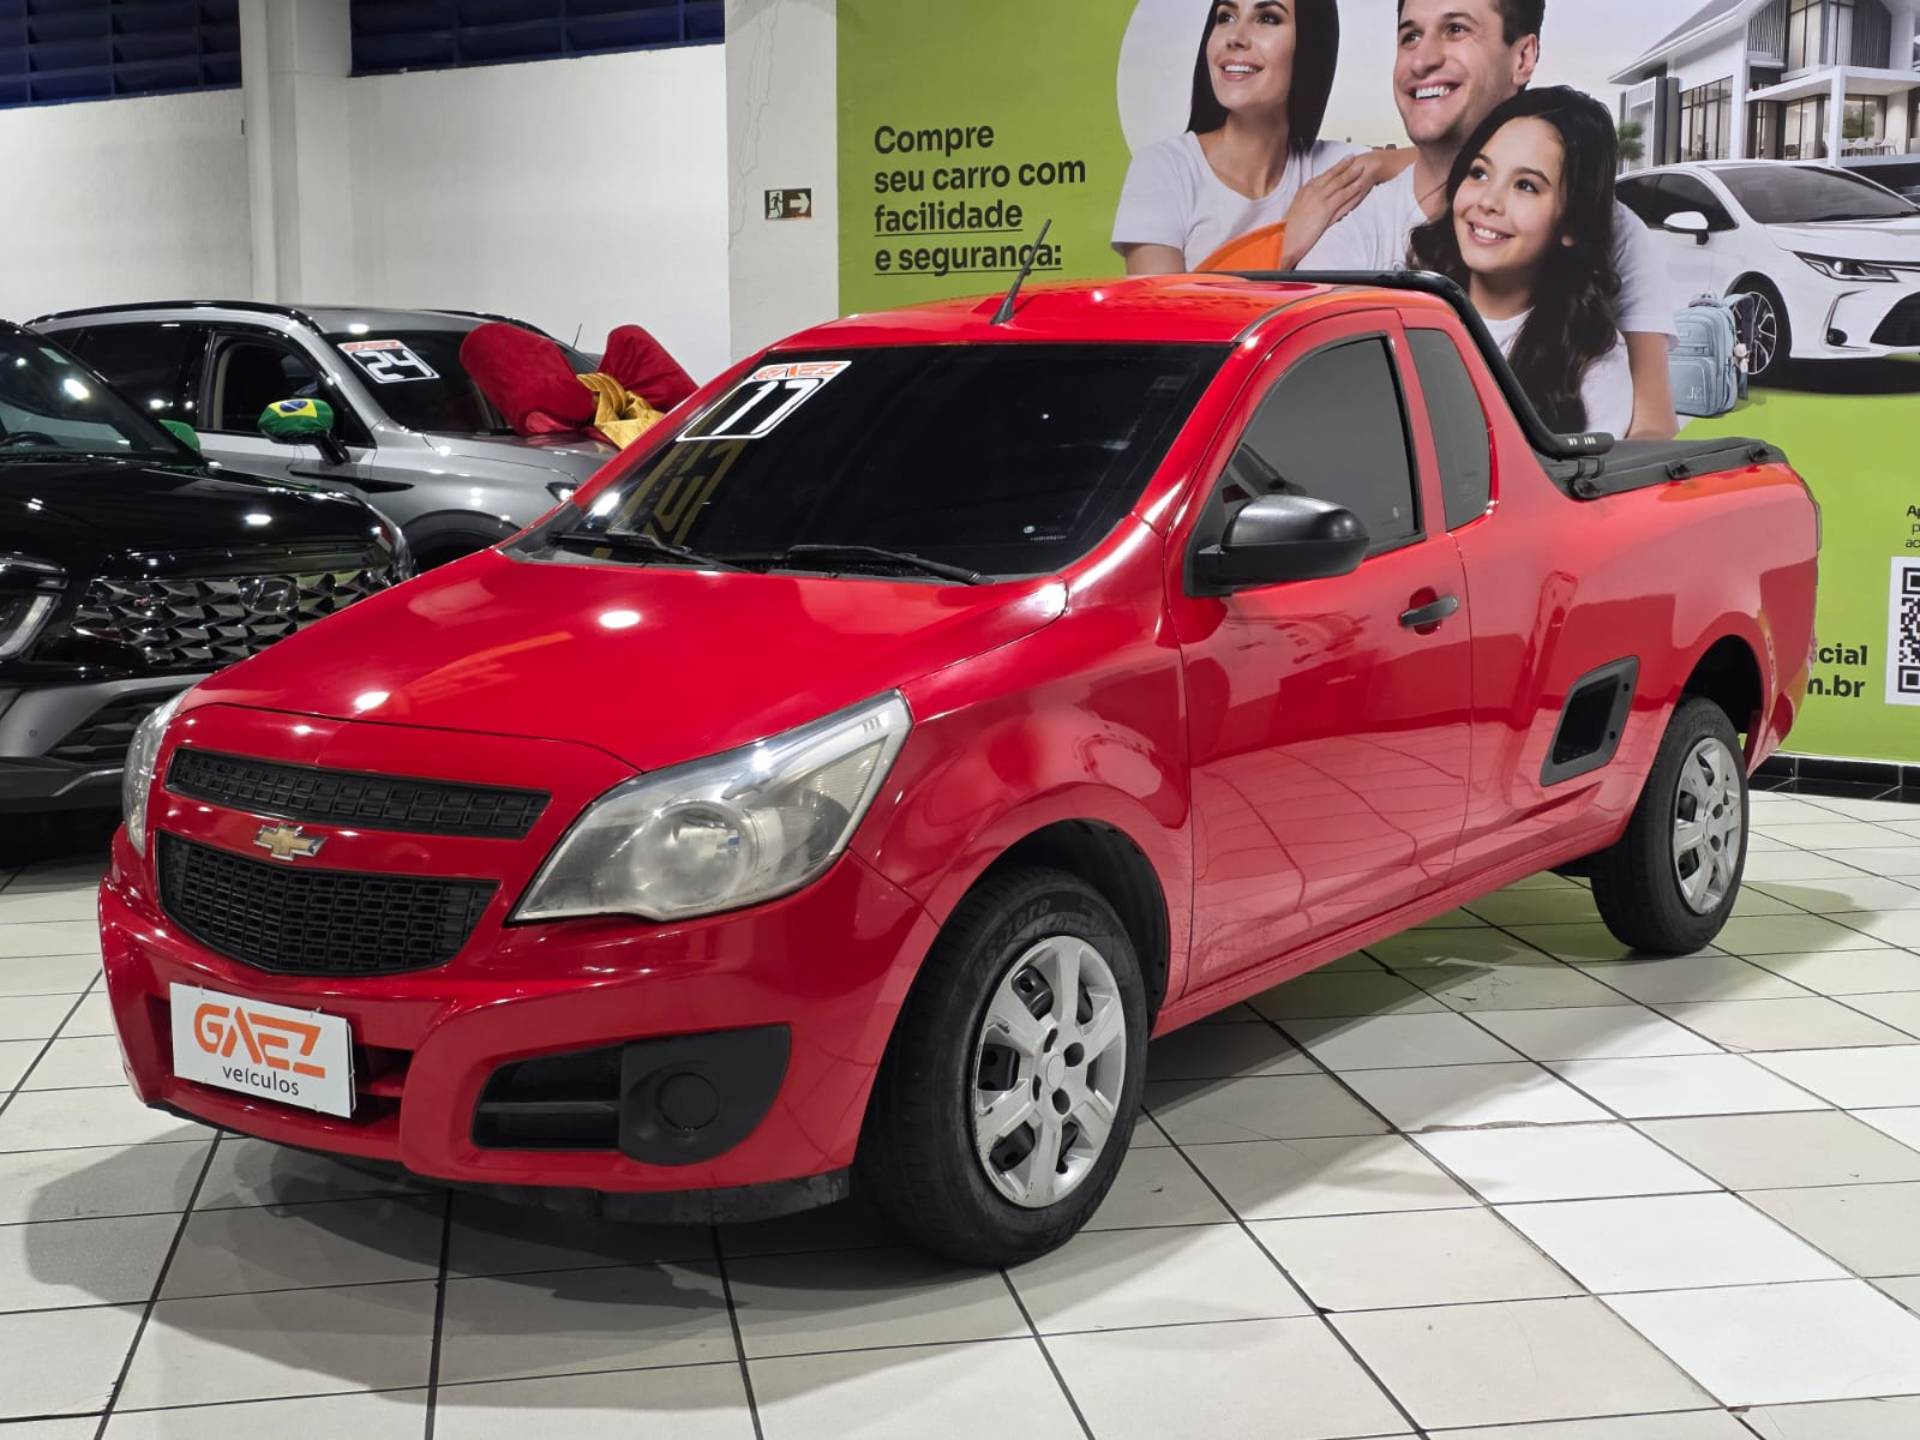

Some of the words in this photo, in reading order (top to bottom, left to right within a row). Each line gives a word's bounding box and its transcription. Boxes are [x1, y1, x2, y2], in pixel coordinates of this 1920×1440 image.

[874, 125, 995, 157] Compre
[874, 168, 924, 193] seu
[932, 164, 1010, 190] carro
[1018, 159, 1086, 186] com
[874, 199, 1023, 232] facilidade
[874, 250, 892, 271] e
[355, 350, 433, 380] 24
[709, 379, 821, 436] 17
[193, 1003, 326, 1079] GAEZ
[222, 1065, 300, 1096] veículos
